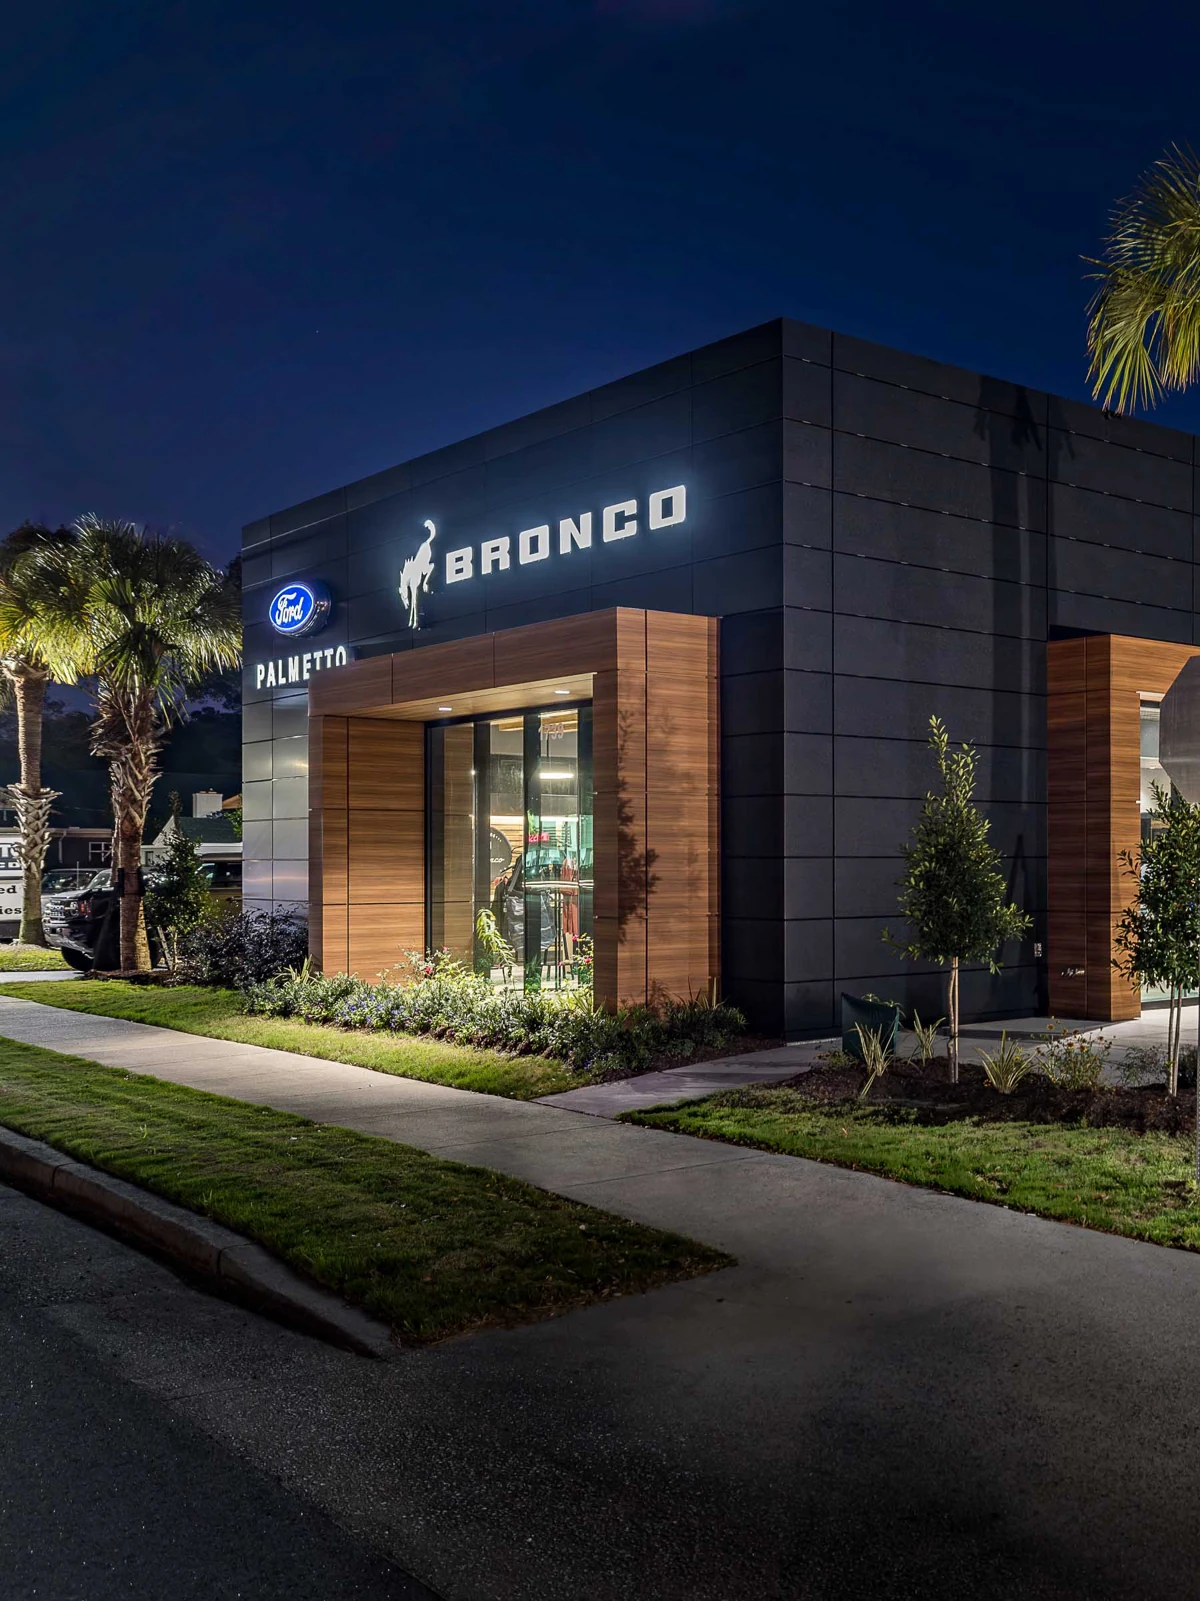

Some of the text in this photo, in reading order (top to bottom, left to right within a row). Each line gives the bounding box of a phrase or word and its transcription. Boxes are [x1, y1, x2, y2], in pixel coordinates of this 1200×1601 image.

[446, 485, 686, 584] BRONCO
[275, 592, 305, 625] Ford
[256, 645, 347, 690] PALMETTO
